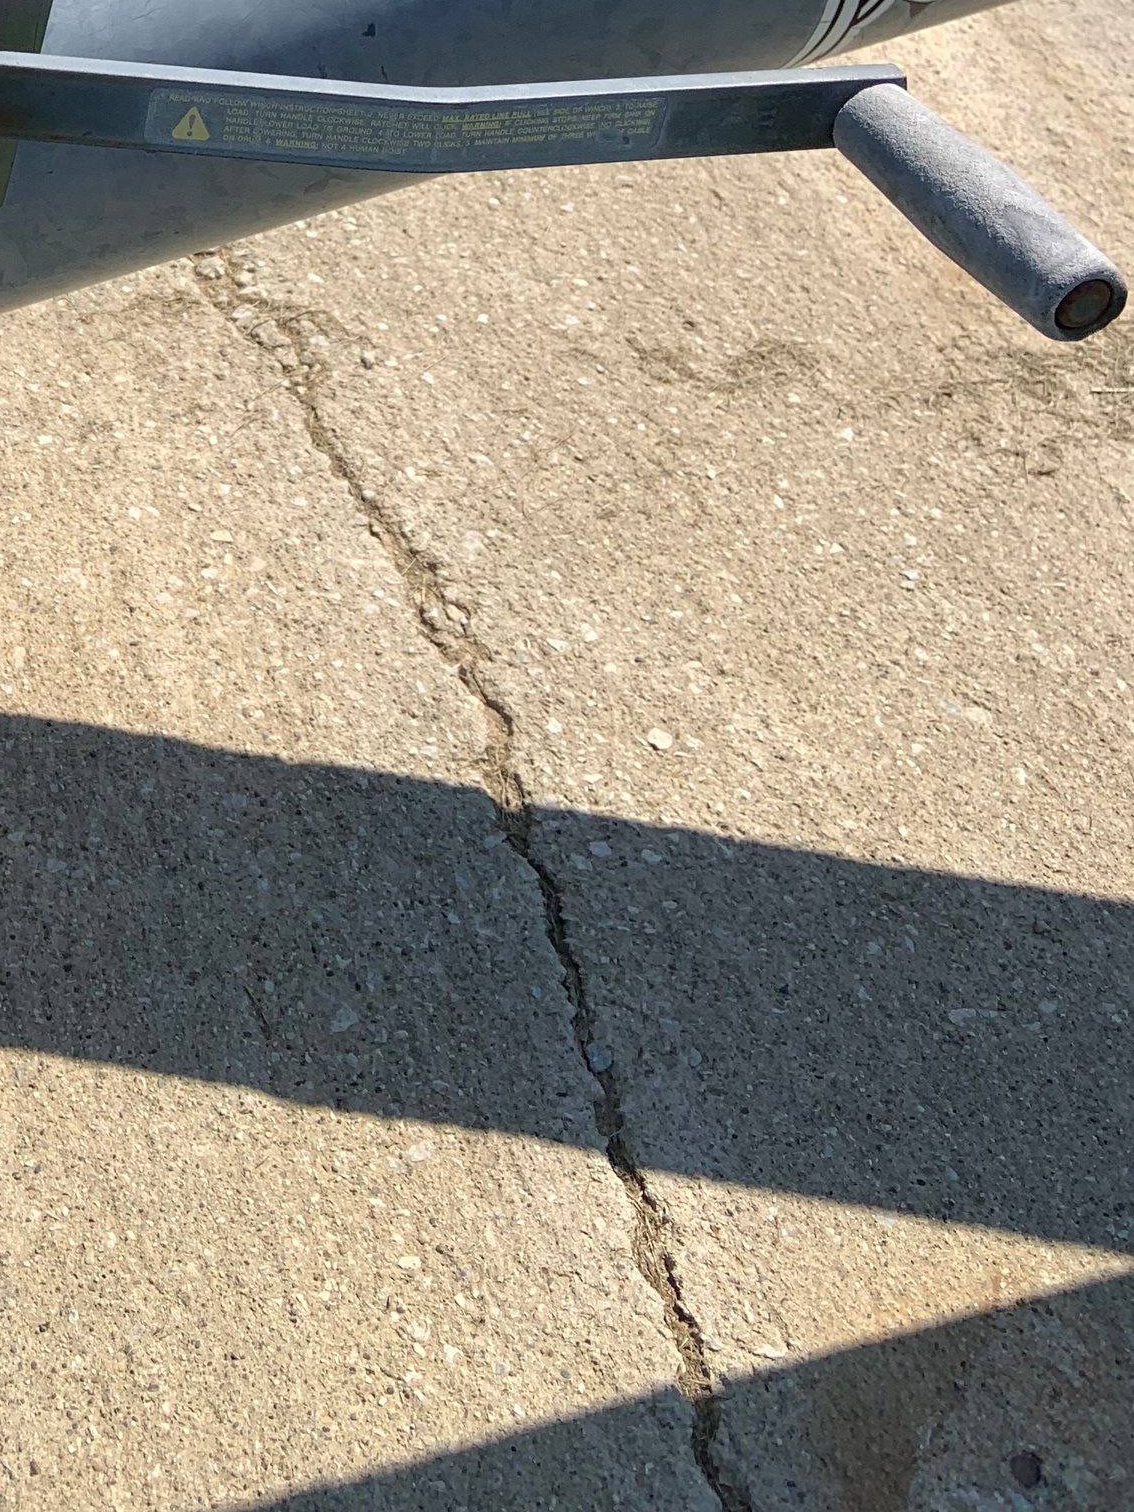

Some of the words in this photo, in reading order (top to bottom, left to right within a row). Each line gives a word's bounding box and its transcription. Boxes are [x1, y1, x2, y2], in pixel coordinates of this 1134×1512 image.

[223, 125, 250, 134] AFTER
[326, 134, 359, 143] HANDLE
[322, 142, 339, 150] NOT
